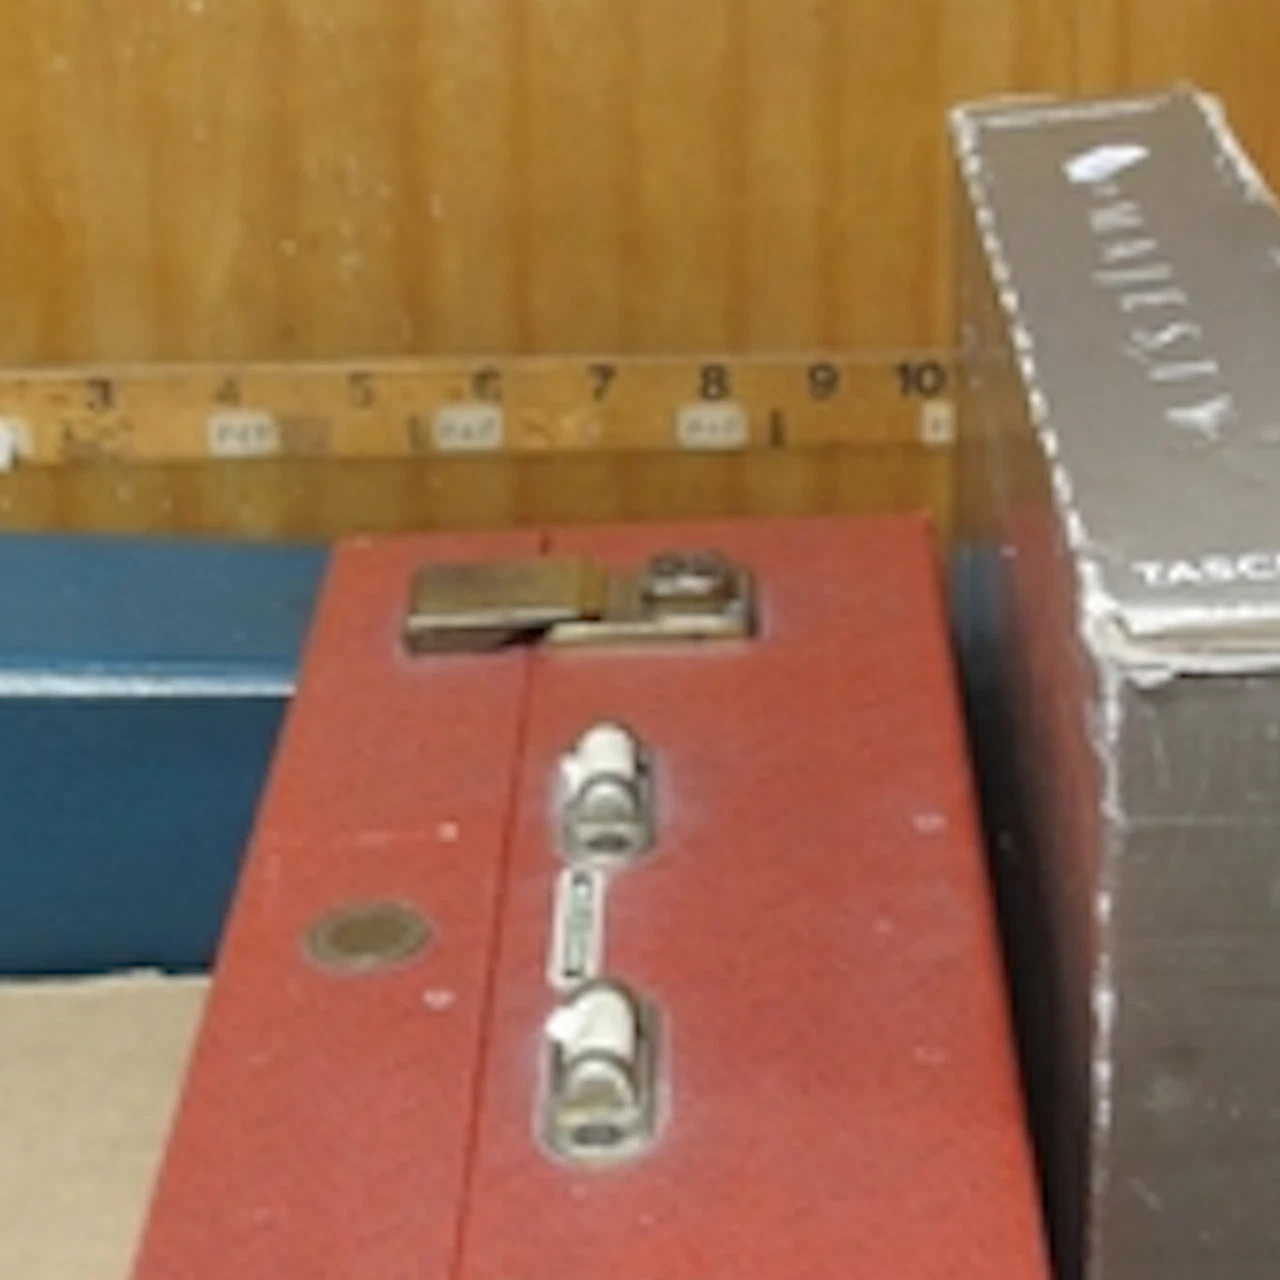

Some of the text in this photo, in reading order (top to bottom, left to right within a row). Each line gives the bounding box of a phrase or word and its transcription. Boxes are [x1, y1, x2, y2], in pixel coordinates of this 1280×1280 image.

[86, 377, 116, 412] 3
[212, 375, 244, 407] 4
[347, 371, 375, 408] 5
[471, 365, 504, 404] 6
[588, 364, 617, 401] 7
[699, 363, 730, 401] 8
[807, 362, 840, 400] 9
[897, 361, 948, 398] 10
